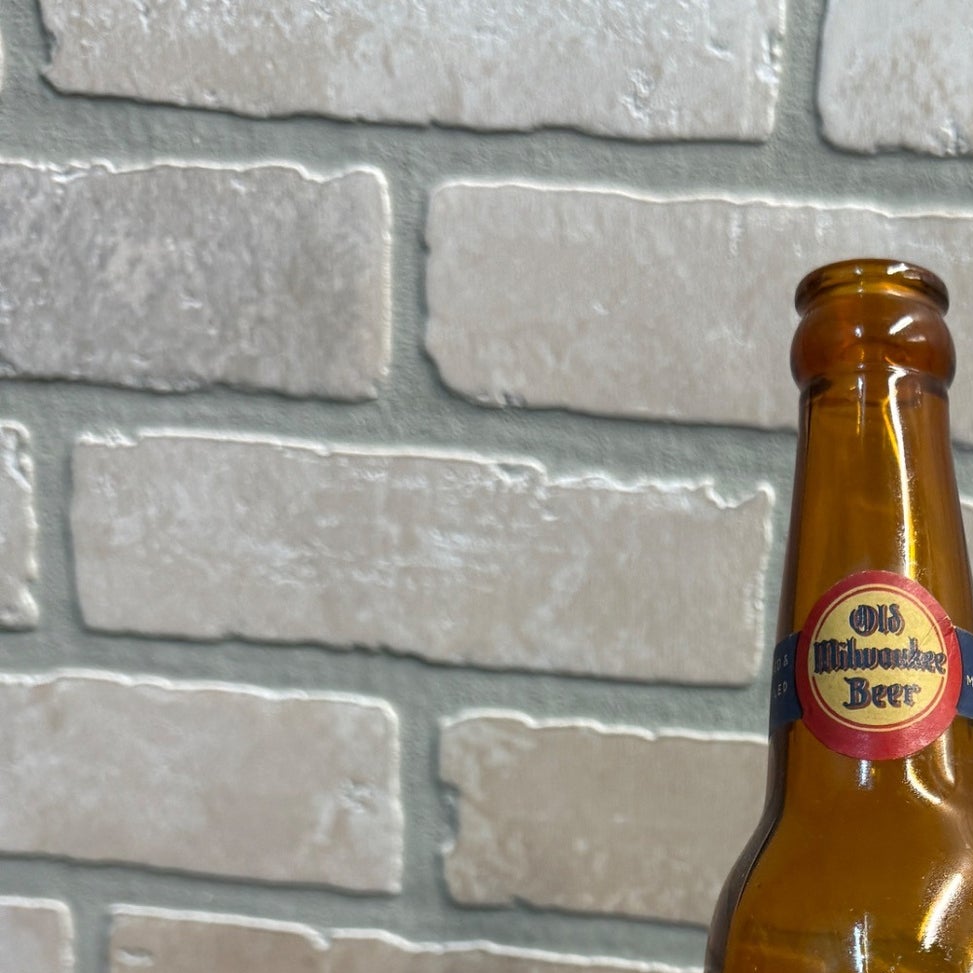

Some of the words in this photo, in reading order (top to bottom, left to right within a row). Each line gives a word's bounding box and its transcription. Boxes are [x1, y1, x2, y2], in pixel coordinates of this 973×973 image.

[849, 603, 905, 636] Old
[813, 636, 947, 675] Milwaukee
[842, 676, 921, 710] Beer
